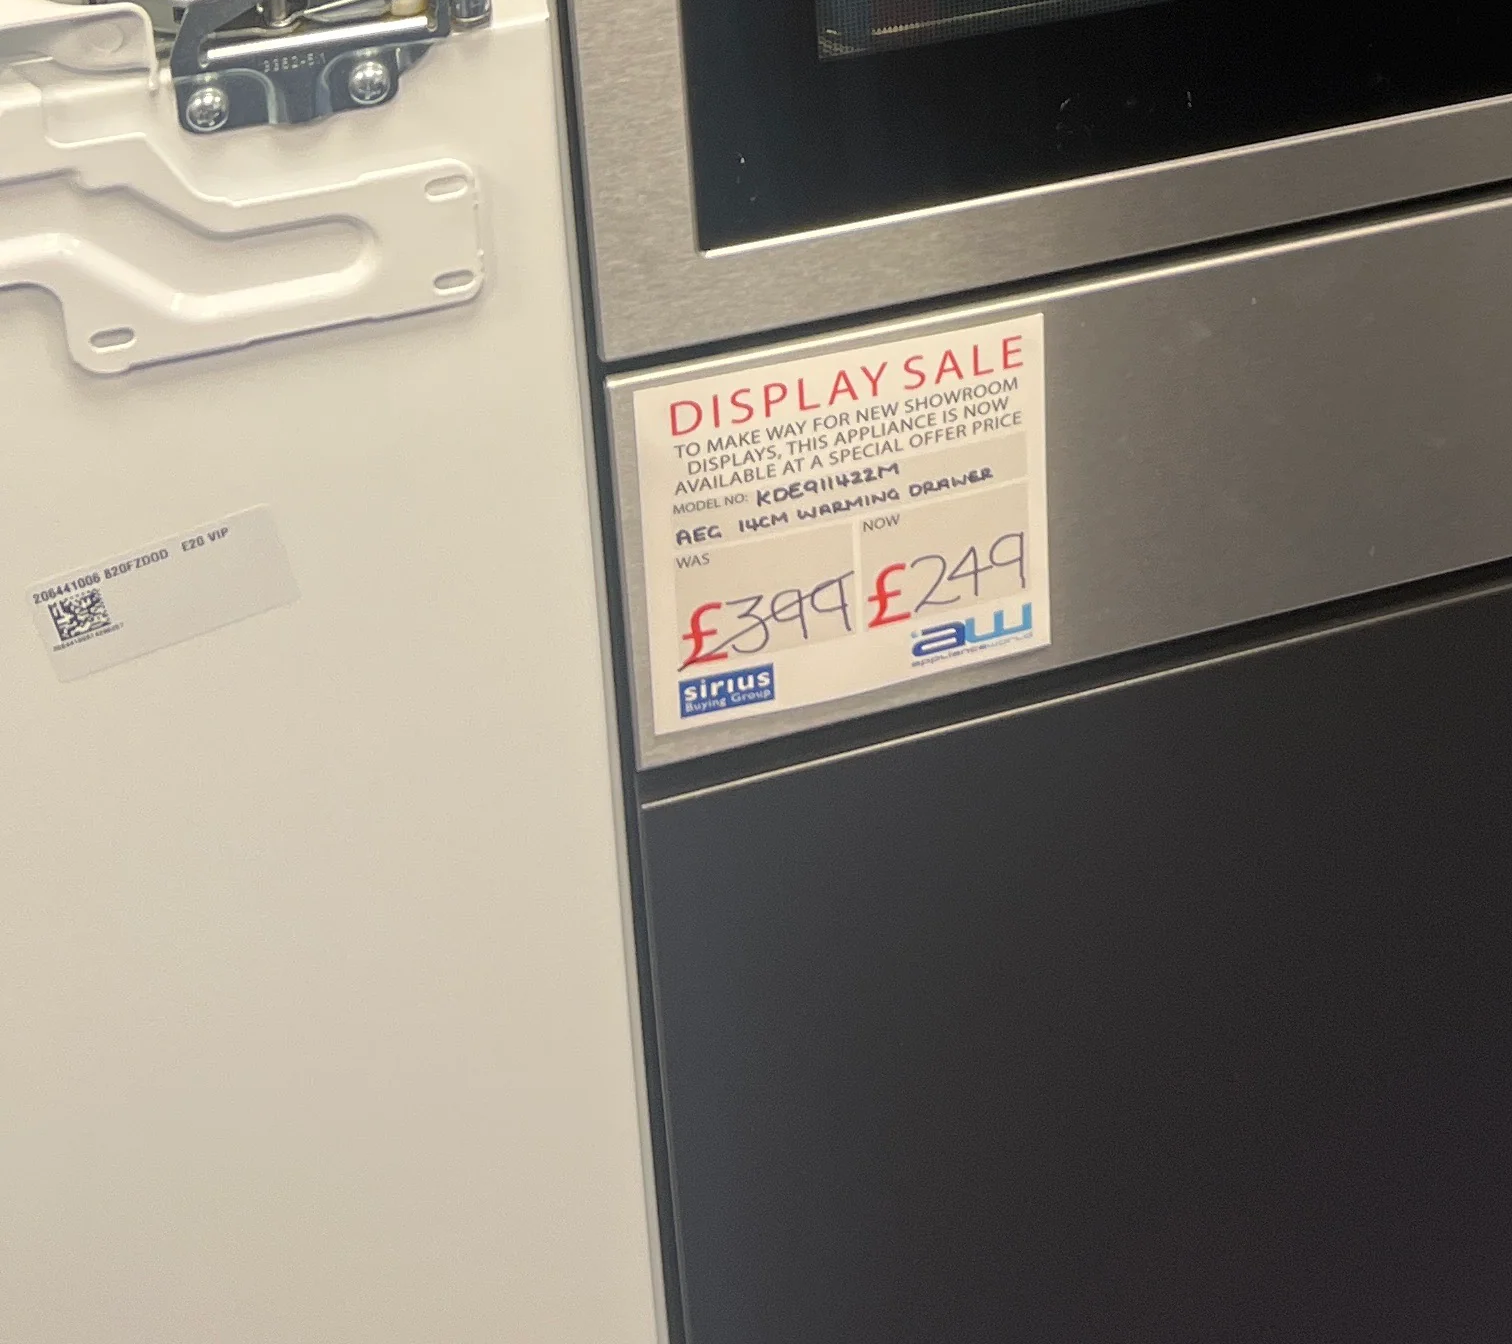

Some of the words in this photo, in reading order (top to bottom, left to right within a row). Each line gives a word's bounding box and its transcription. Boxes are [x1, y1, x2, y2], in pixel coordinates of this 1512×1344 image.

[669, 361, 888, 437] DISPLAY
[903, 335, 1024, 391] SALE
[673, 441, 701, 459] TO
[706, 429, 761, 454] MAKE
[765, 419, 807, 441] WAY
[813, 411, 850, 432] FOR
[856, 401, 900, 424] NEW
[904, 376, 1019, 414] SHOWROOM
[687, 444, 783, 476] DISPLAYS,
[786, 434, 829, 457] THIS
[833, 412, 937, 446] APPLIANCE
[943, 408, 958, 424] IS
[964, 395, 1010, 420] NOW
[674, 463, 778, 496] AVAILABLE
[782, 457, 806, 476] AT
[810, 454, 824, 471] A
[828, 437, 904, 466] SPECIAL
[909, 423, 967, 449] OFFER
[972, 410, 1022, 436] PRICE
[672, 498, 722, 515] MODEL
[738, 510, 790, 535] 14CM
[796, 490, 901, 522] WARMING
[909, 467, 994, 499] DRAWER
[207, 526, 230, 543] VIP
[862, 514, 901, 534] NOW
[675, 552, 711, 569] WAS
[683, 670, 771, 703] sirius
[684, 697, 727, 714] Buying
[731, 686, 771, 704] Group
